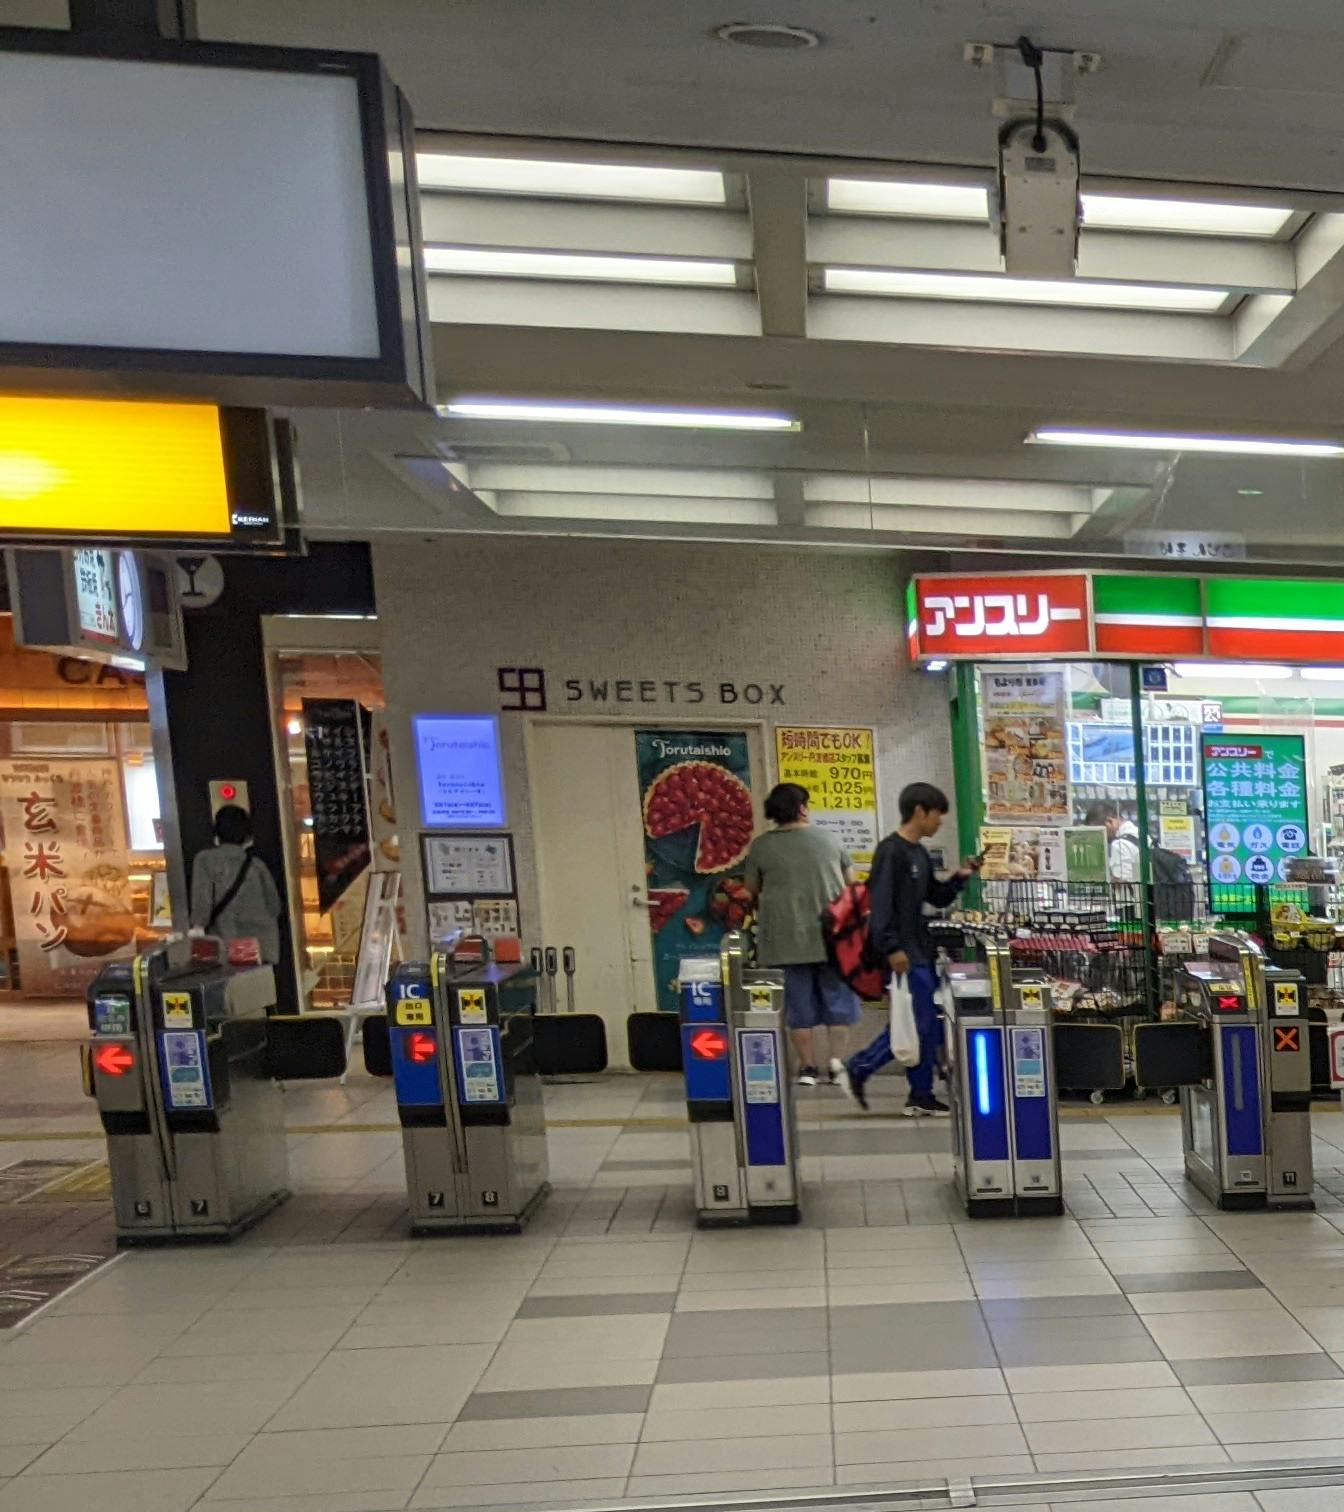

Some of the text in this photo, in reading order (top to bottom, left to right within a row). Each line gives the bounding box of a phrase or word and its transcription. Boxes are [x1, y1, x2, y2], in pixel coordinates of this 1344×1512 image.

[923, 593, 1082, 637] アンスリー
[564, 680, 786, 705] SWEETS BOX
[652, 738, 732, 758] Torutaishio
[1207, 762, 1300, 779] 公共料金
[1207, 781, 1301, 797] 各種料金
[1208, 800, 1301, 809] お支払い承ります
[17, 790, 68, 954] 玄米パン
[400, 984, 421, 998] IC
[691, 982, 712, 996] IC
